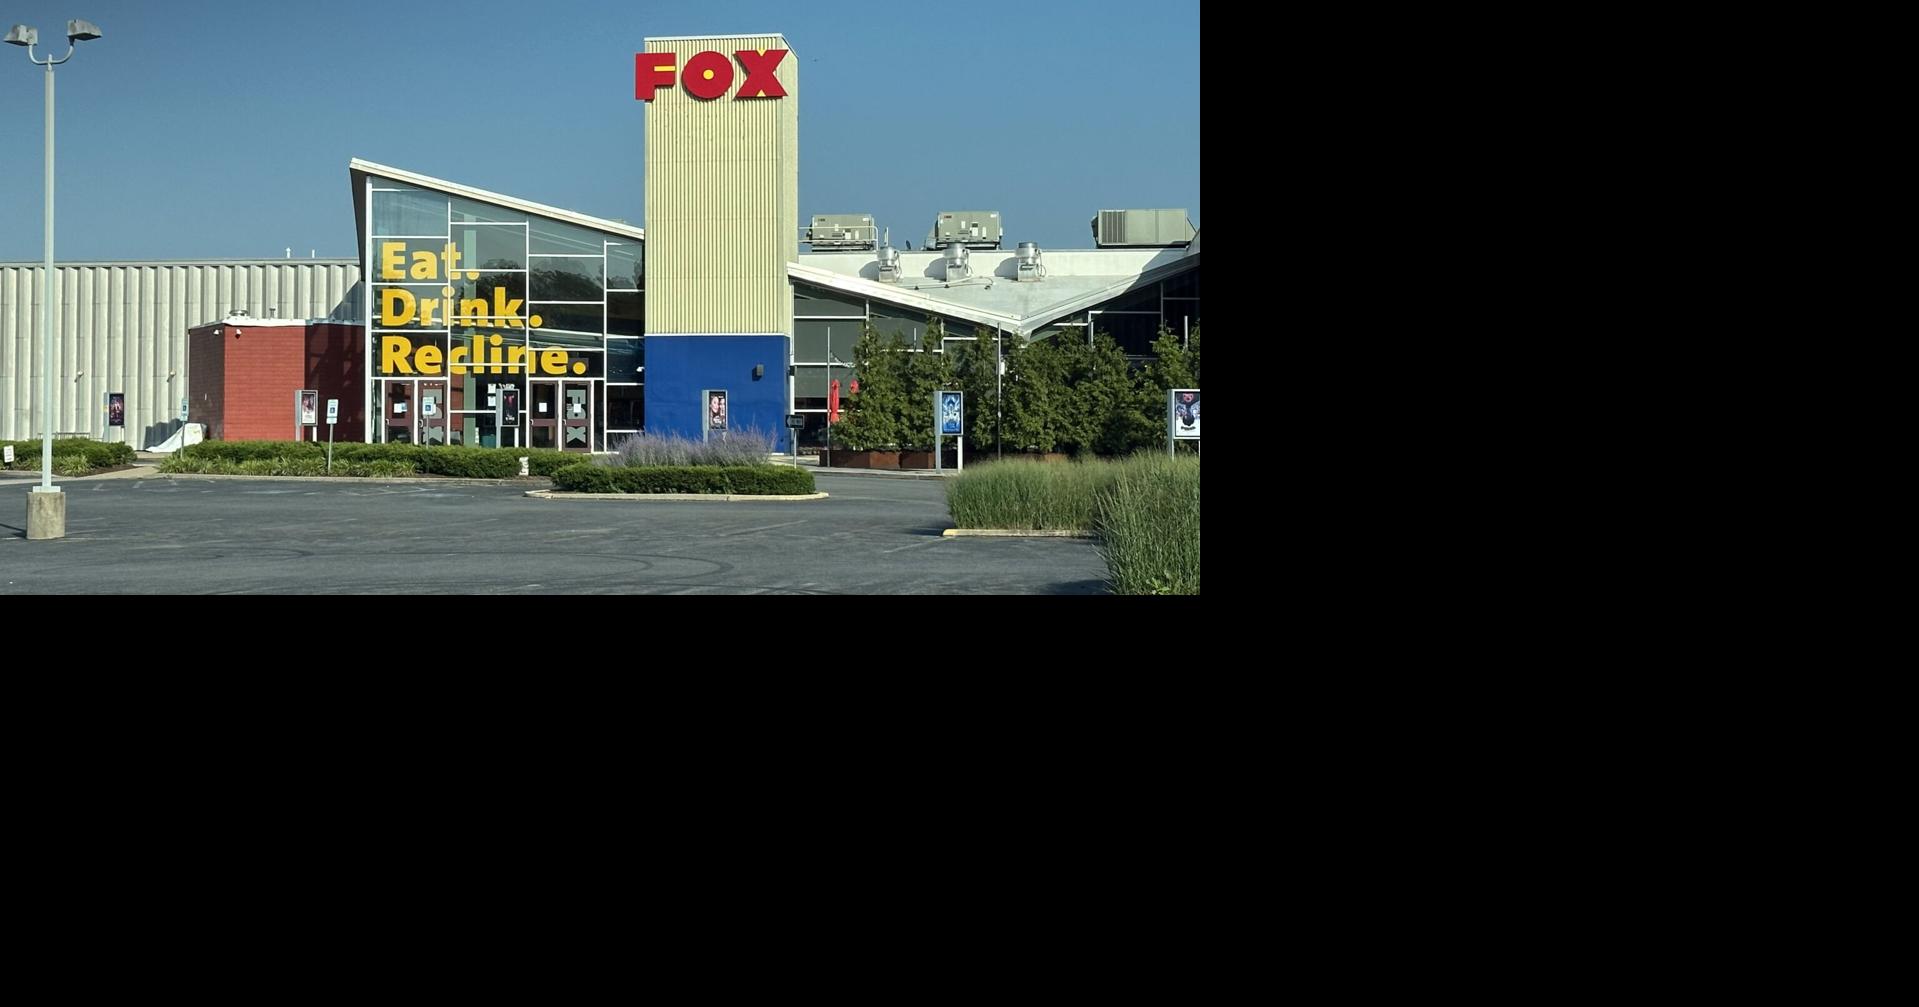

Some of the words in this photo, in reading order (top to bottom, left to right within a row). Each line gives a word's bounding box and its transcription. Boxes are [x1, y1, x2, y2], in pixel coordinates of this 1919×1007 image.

[635, 49, 789, 102] FOX
[382, 242, 480, 280] Eat.
[382, 287, 543, 328] Drink.
[382, 334, 587, 375] Recline.
